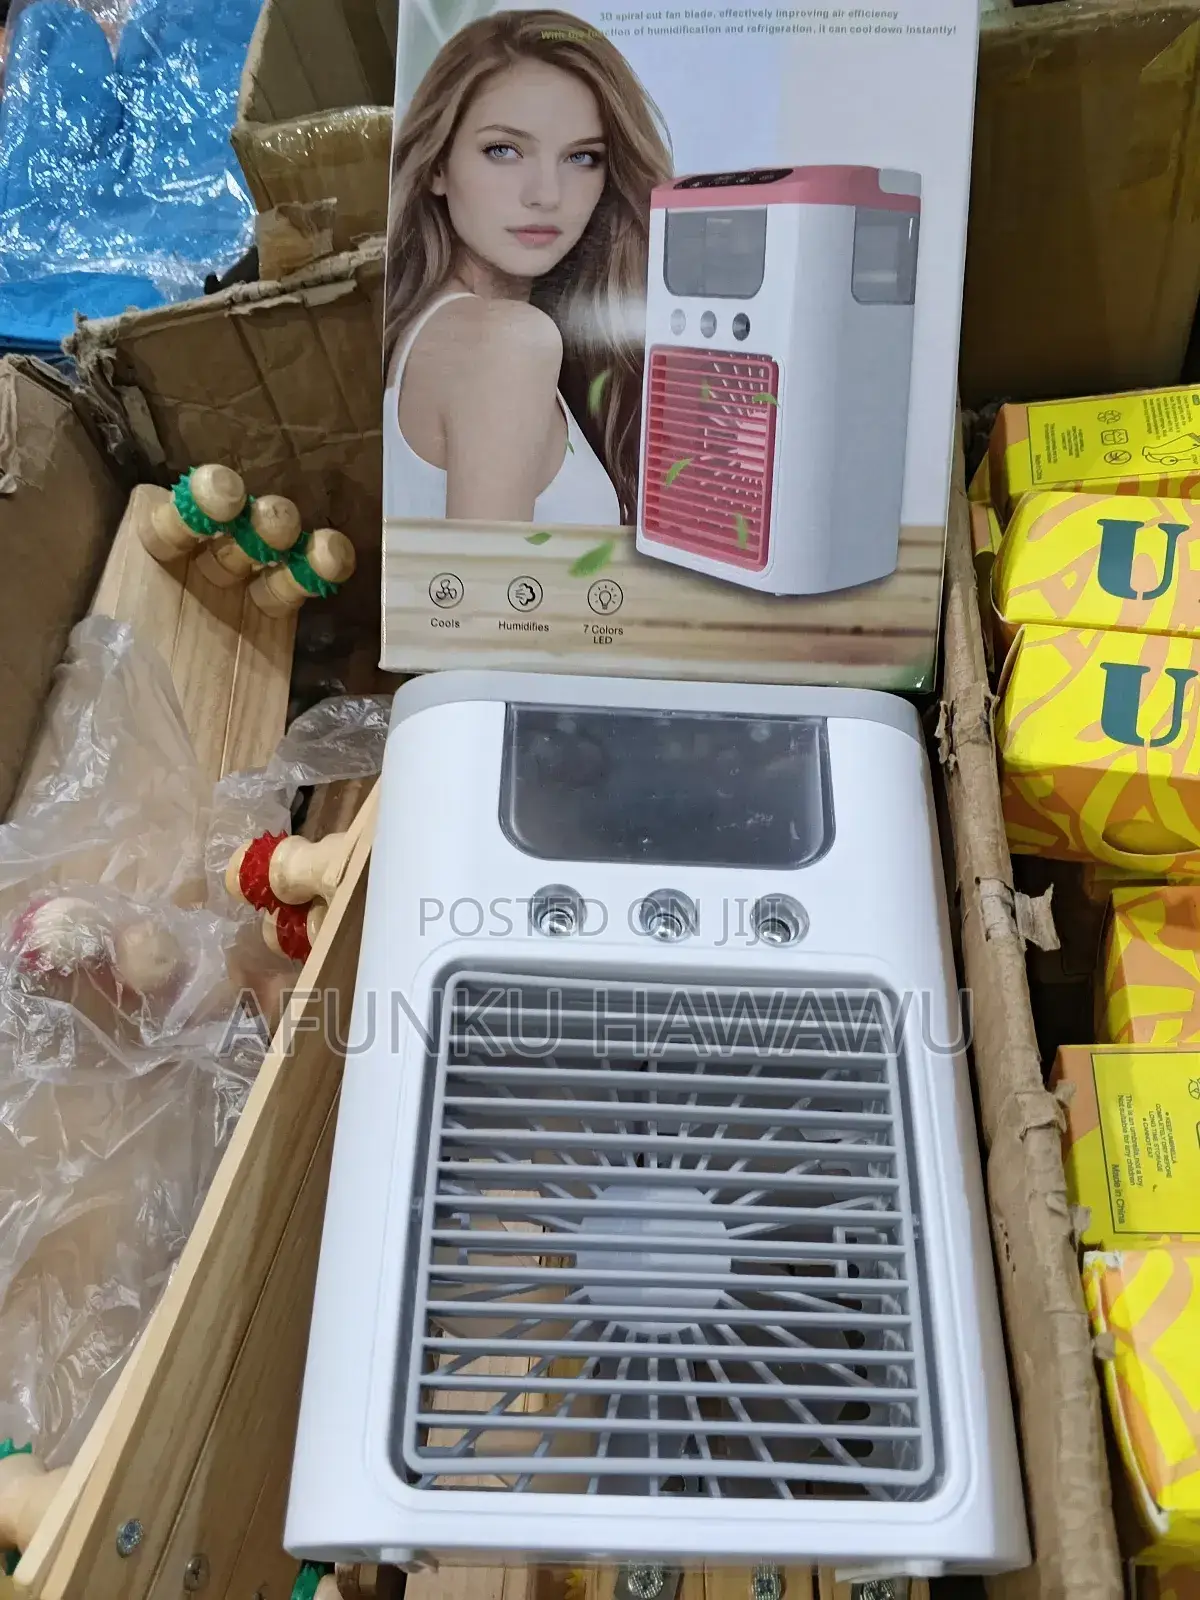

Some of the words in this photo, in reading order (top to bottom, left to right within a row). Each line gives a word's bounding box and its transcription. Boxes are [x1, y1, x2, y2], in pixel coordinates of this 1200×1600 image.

[615, 11, 643, 22] spiral
[665, 10, 681, 20] fan
[719, 8, 772, 19] effectively
[775, 8, 829, 19] improving
[832, 9, 845, 18] air
[848, 9, 899, 20] efficiency
[634, 26, 644, 36] of
[648, 24, 721, 36] humidification
[725, 24, 744, 34] and
[818, 24, 826, 33] it
[829, 25, 847, 34] can
[849, 24, 873, 34] cool
[874, 24, 903, 34] down
[430, 618, 460, 629] Cools
[498, 621, 550, 633] Humidifies
[583, 625, 589, 635] 7
[591, 625, 624, 636] Colors
[593, 635, 613, 645] LED
[1120, 1108, 1128, 1133] suitable
[1127, 1159, 1136, 1185] children
[1111, 1164, 1123, 1187] Made
[1115, 1189, 1123, 1197] in
[1116, 1199, 1126, 1224] China
